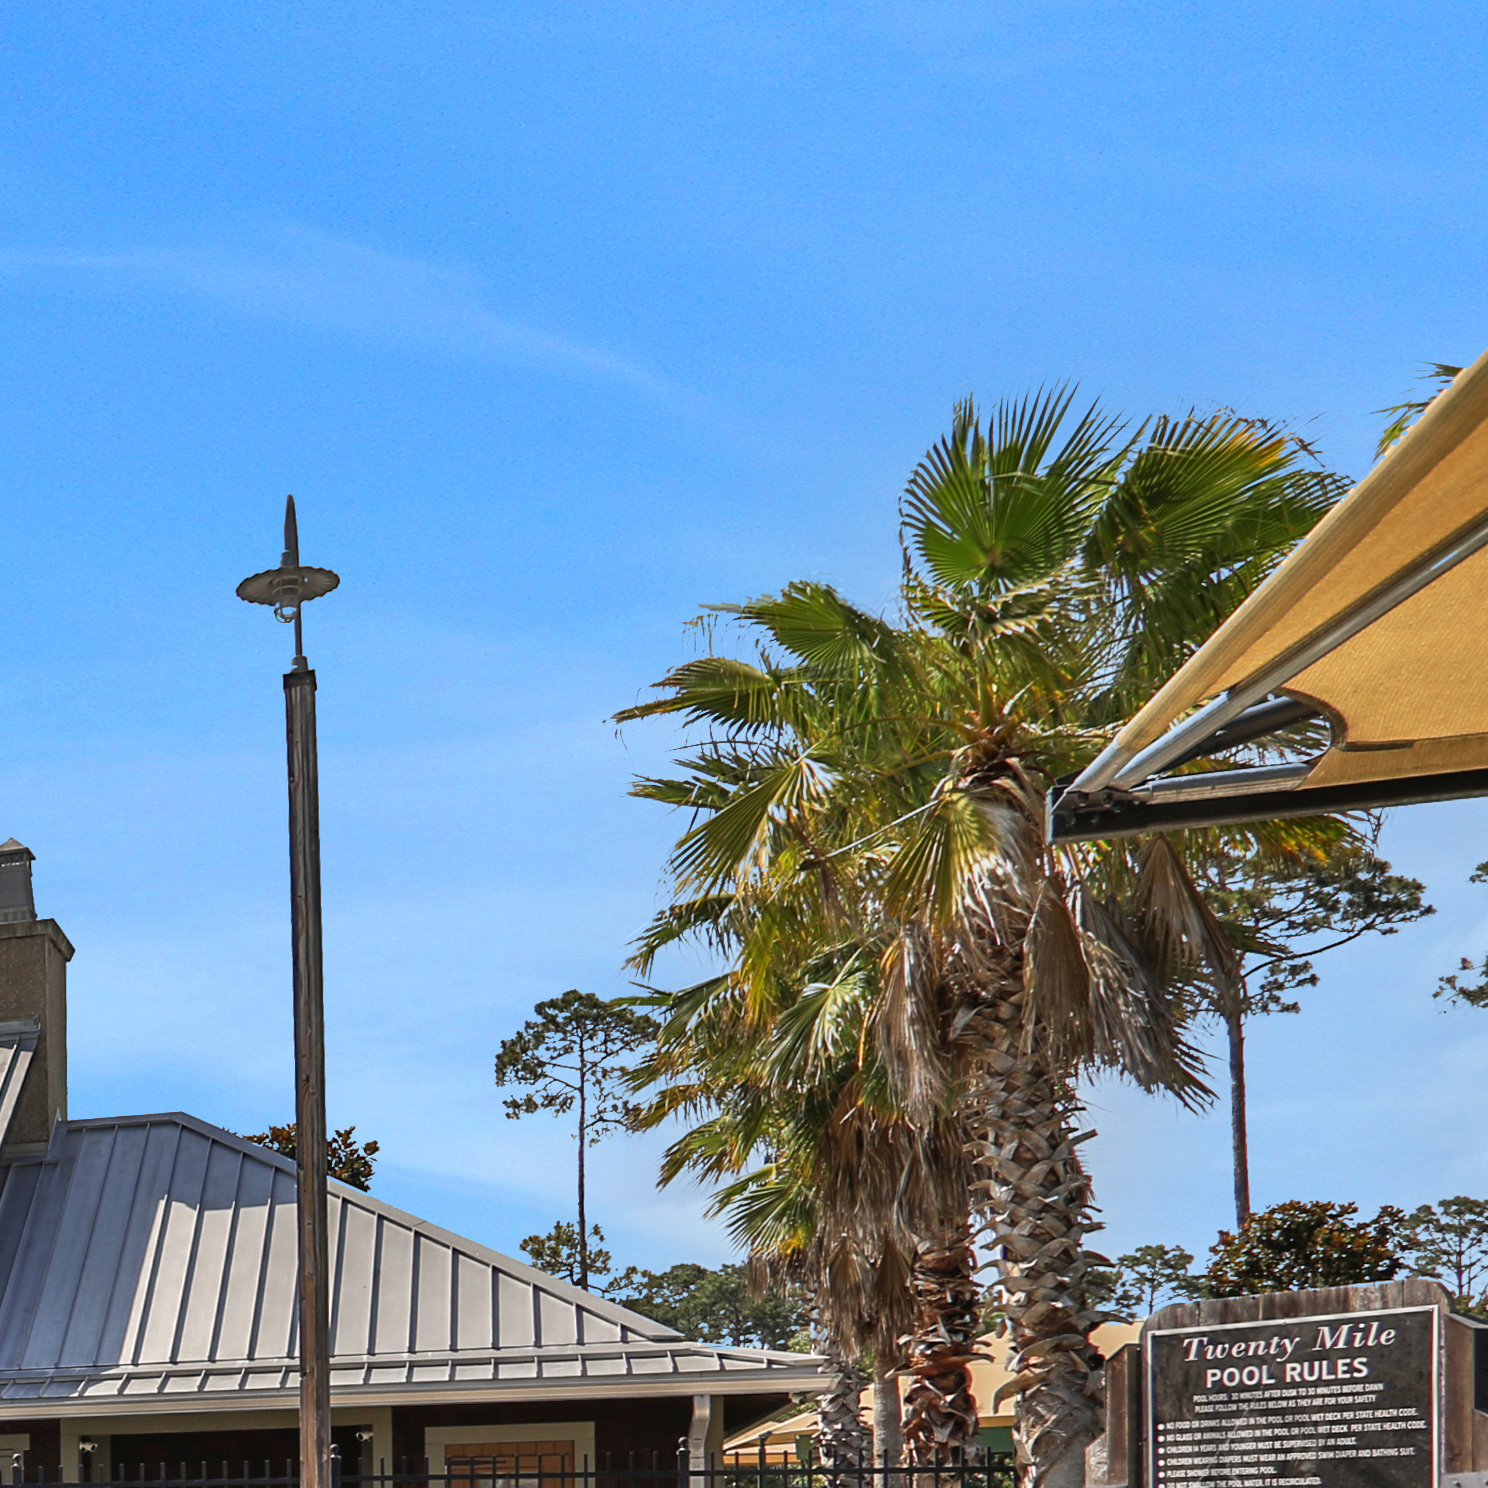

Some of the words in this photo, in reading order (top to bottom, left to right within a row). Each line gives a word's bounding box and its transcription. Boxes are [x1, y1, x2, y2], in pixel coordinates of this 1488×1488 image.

[1182, 1336, 1300, 1362] Twenty
[1311, 1321, 1396, 1351] Mile
[1206, 1364, 1275, 1387] POOL
[1285, 1357, 1368, 1382] RULES
[1316, 1385, 1341, 1394] MINUTES
[1342, 1384, 1363, 1392] BEFORE
[1365, 1382, 1383, 1391] DAWN
[1194, 1404, 1214, 1413] PLEASE
[1215, 1403, 1237, 1412] FOLLOW
[1249, 1401, 1266, 1409] RULES
[1267, 1400, 1287, 1408] BELOW
[1354, 1394, 1376, 1403] SAFETY
[1221, 1417, 1247, 1426] ALLOWED
[1355, 1410, 1373, 1418] STATE
[1374, 1408, 1397, 1417] HEALTH
[1398, 1407, 1418, 1416] CODE.
[1175, 1432, 1192, 1441] GLASS
[1331, 1424, 1348, 1433] DECK
[1363, 1422, 1381, 1431] STATE
[1382, 1421, 1406, 1430] HEALTH
[1407, 1420, 1426, 1429] CODE.
[1336, 1436, 1356, 1445] ADULT.
[1286, 1451, 1316, 1460] APPROVED
[1335, 1450, 1356, 1458] DIAPER
[1371, 1448, 1398, 1456] BATHING
[1166, 1469, 1185, 1477] PLEASE
[1259, 1466, 1277, 1474] POOL.
